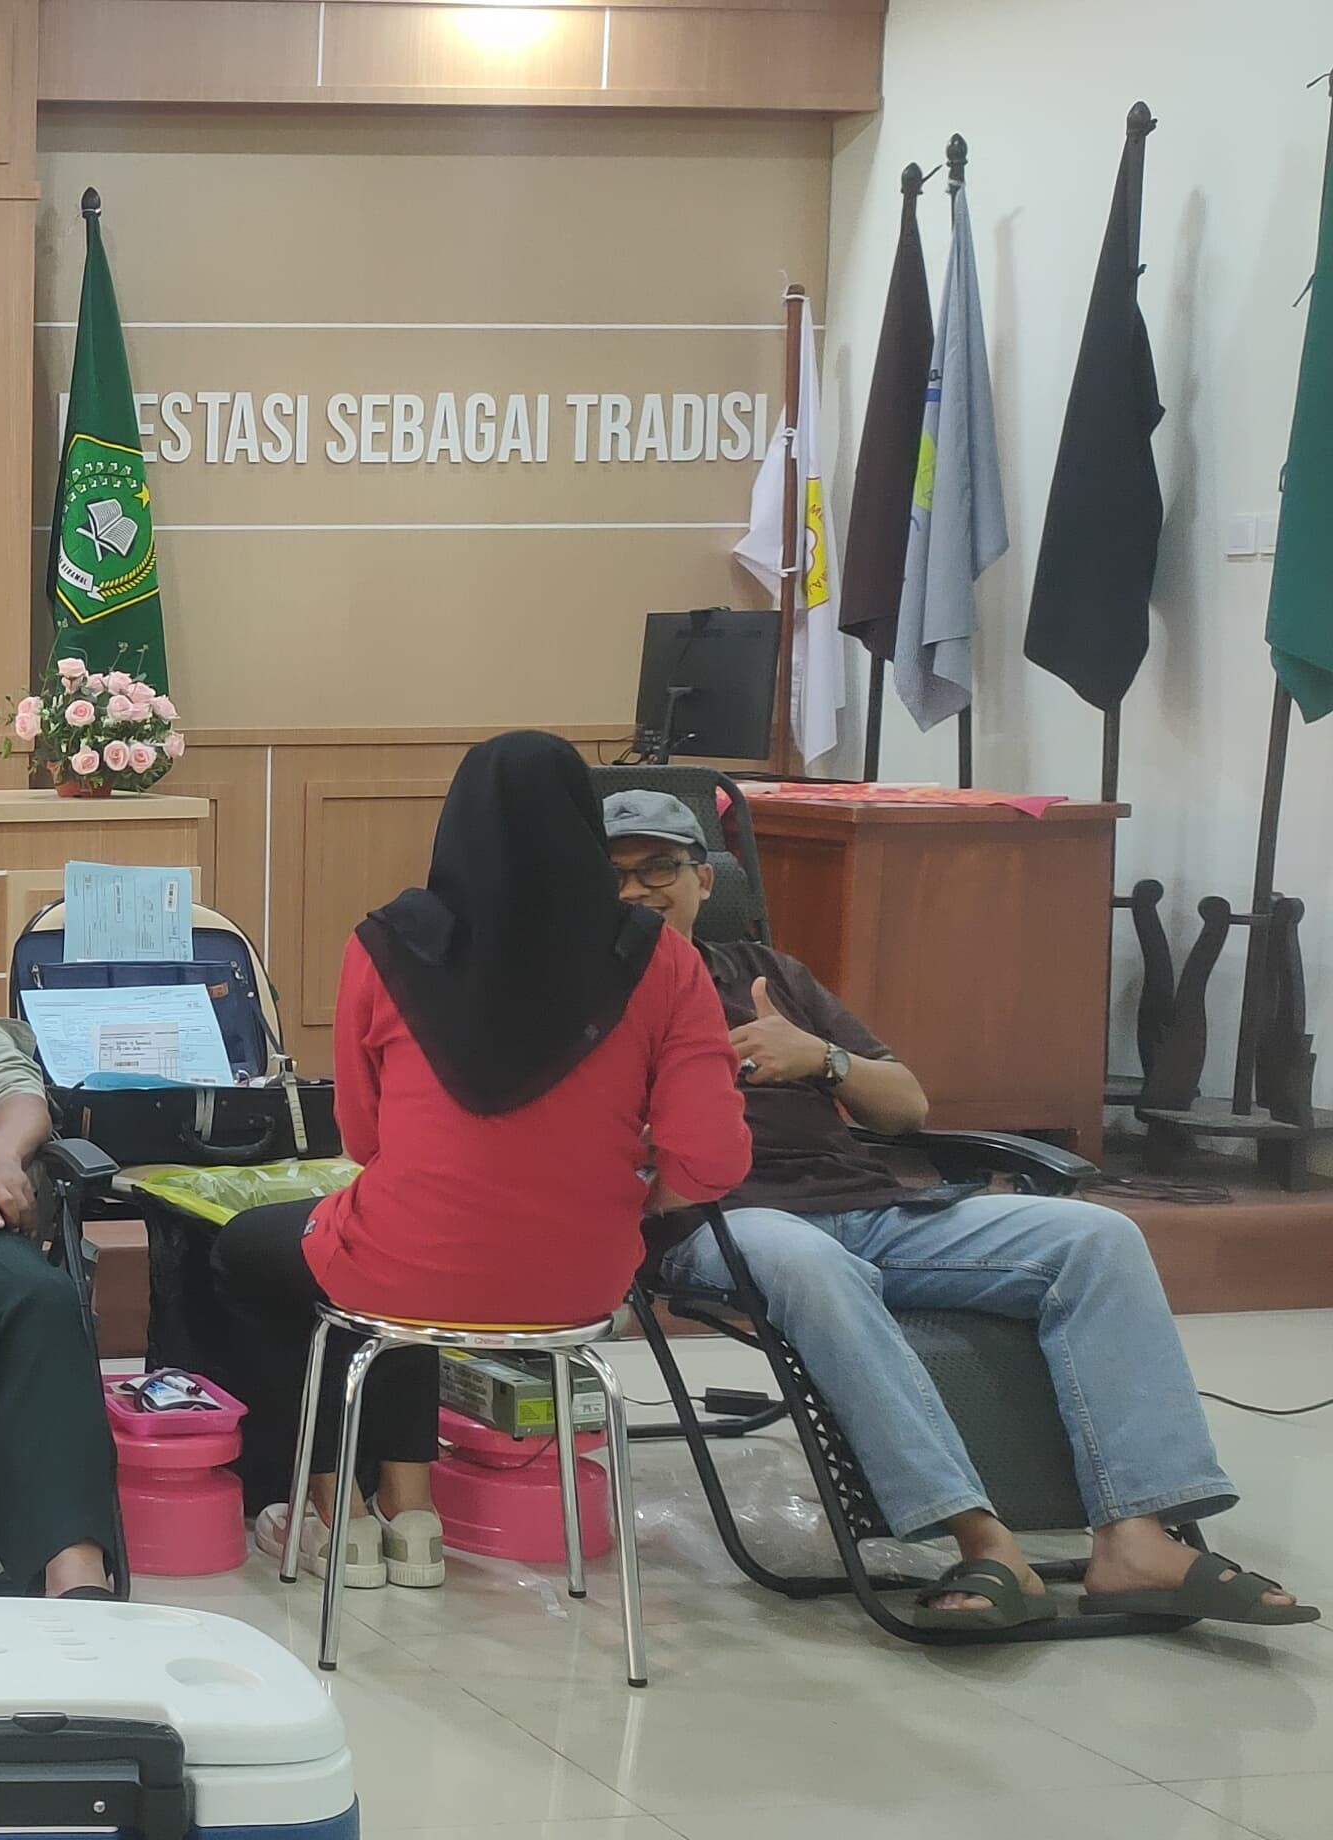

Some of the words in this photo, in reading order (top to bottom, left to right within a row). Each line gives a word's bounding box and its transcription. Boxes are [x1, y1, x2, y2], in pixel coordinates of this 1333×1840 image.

[59, 391, 310, 464] ESTASI
[325, 391, 550, 464] SEBAGAI
[565, 391, 768, 463] TRADISI
